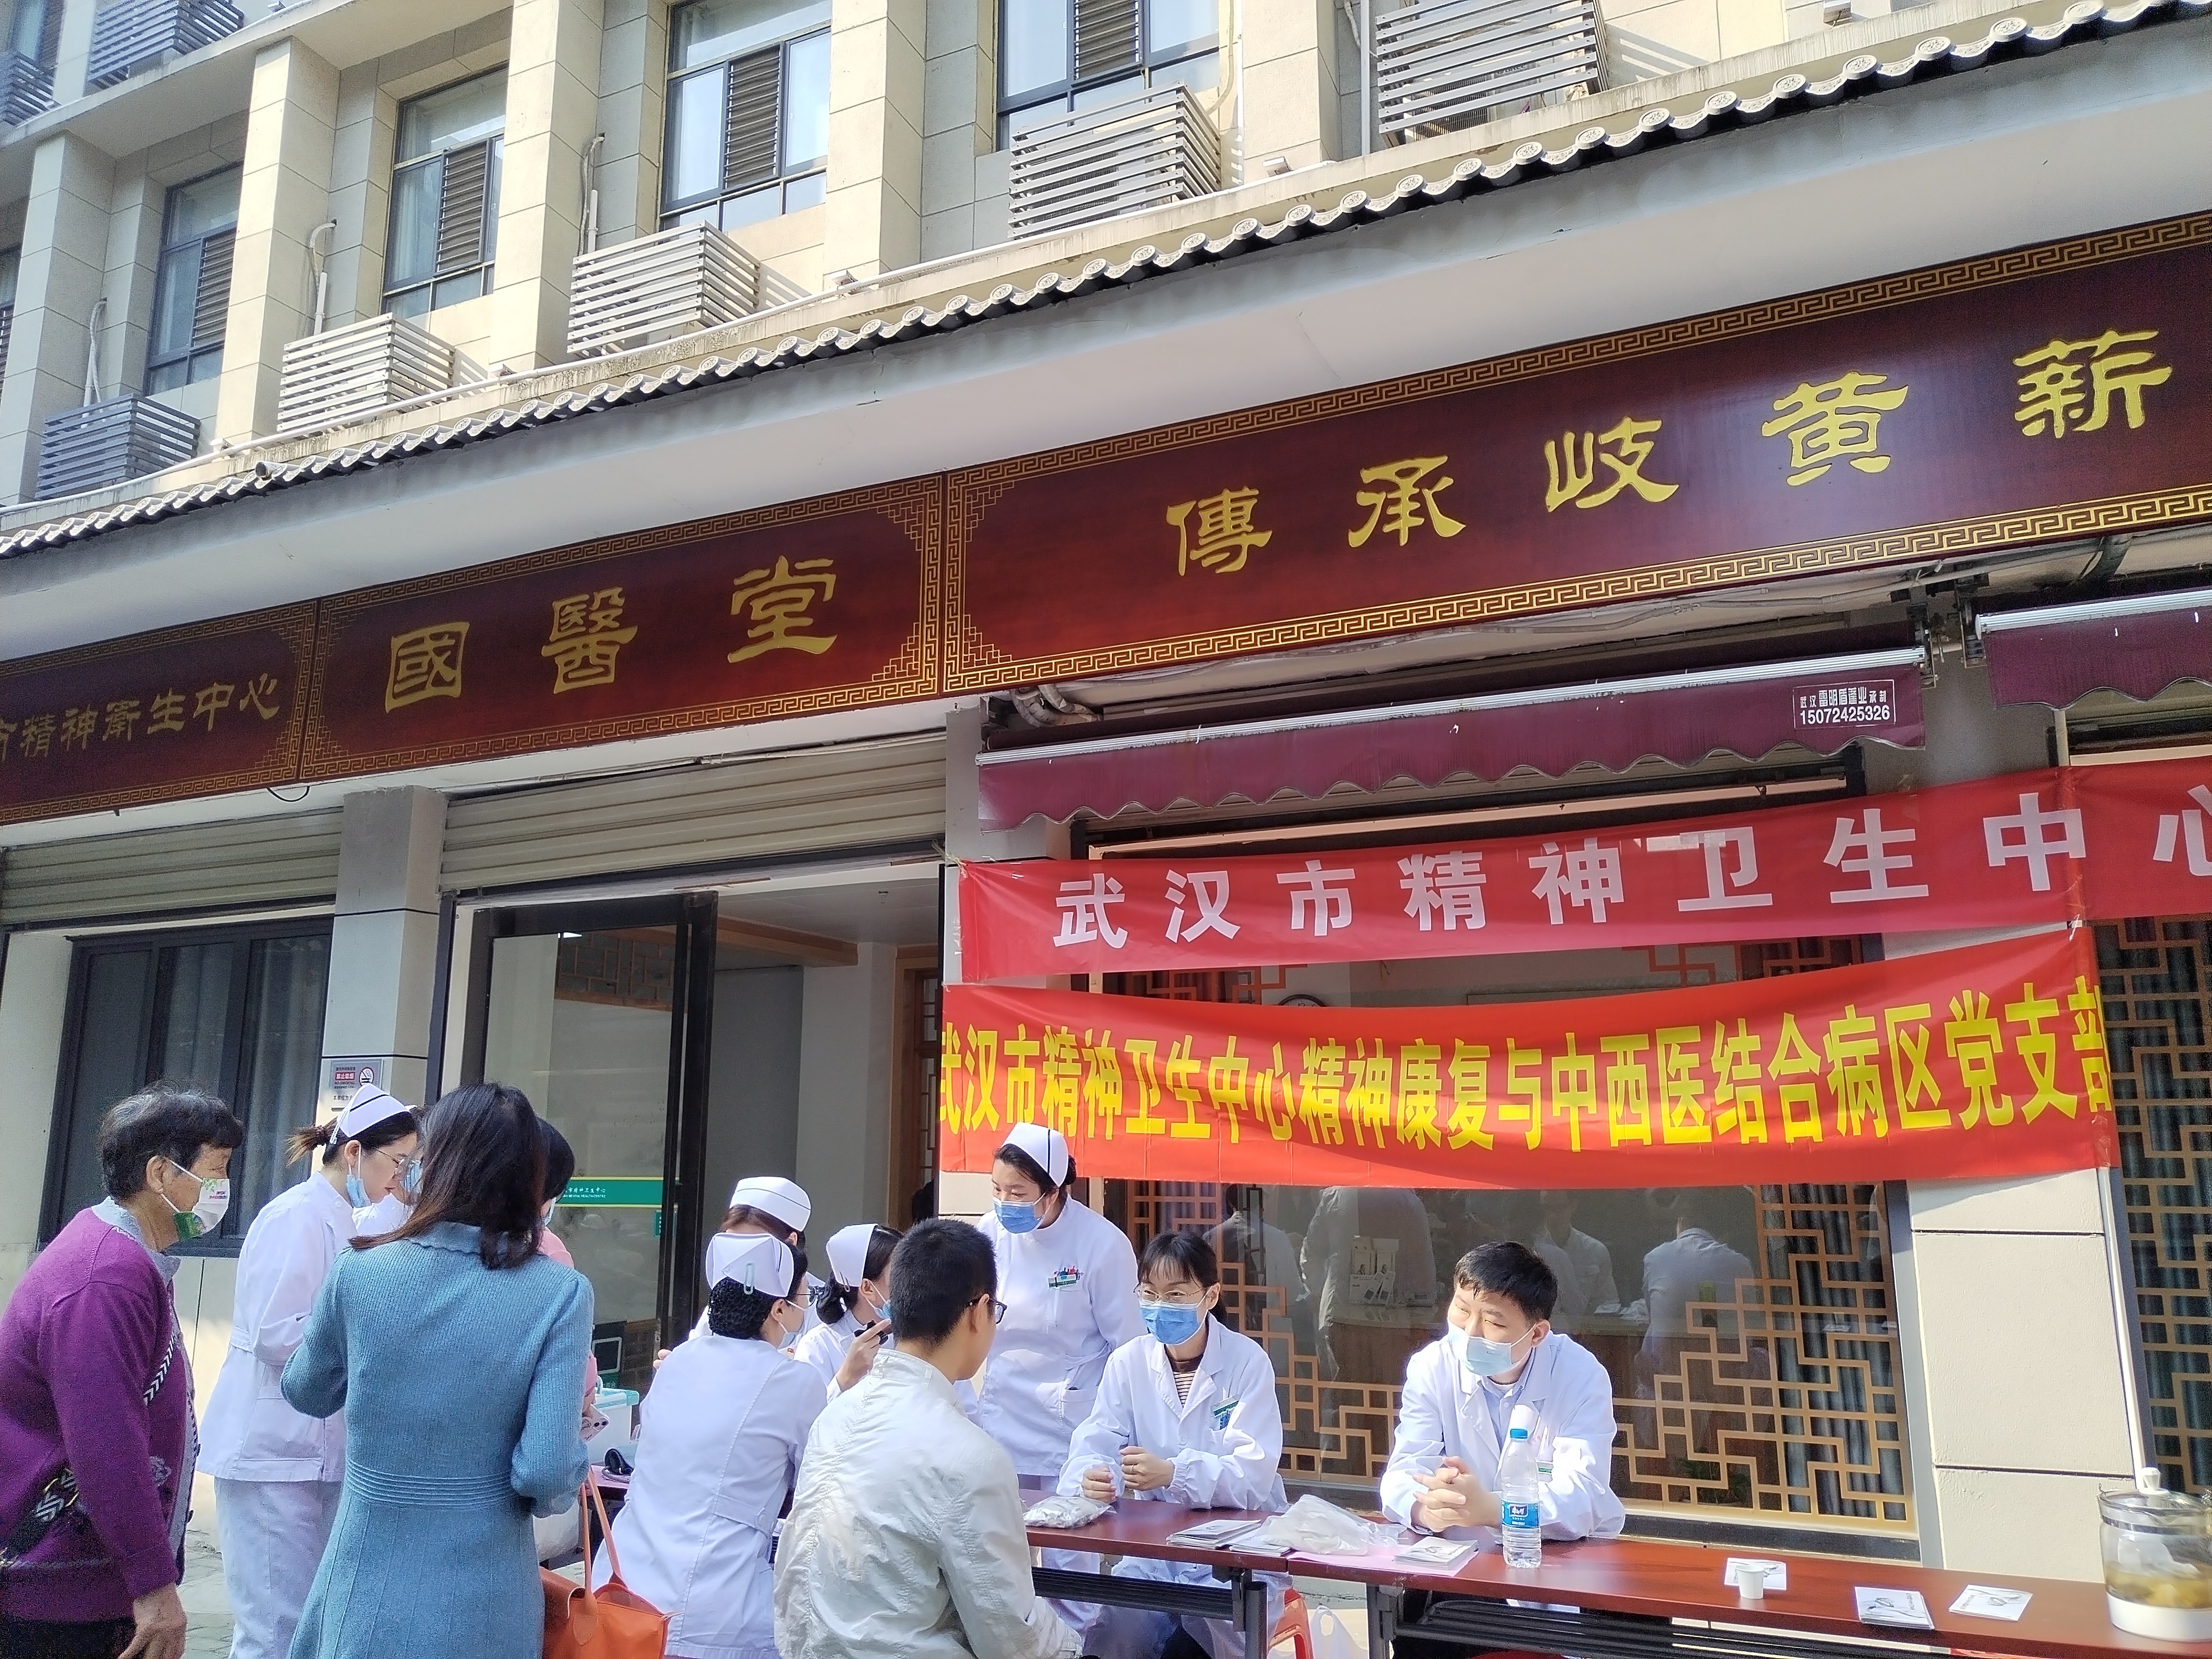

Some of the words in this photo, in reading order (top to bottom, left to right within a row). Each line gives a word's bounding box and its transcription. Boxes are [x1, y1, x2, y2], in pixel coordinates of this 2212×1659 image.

[385, 555, 837, 713] 國醫堂
[1800, 705, 1890, 724] 15072425326
